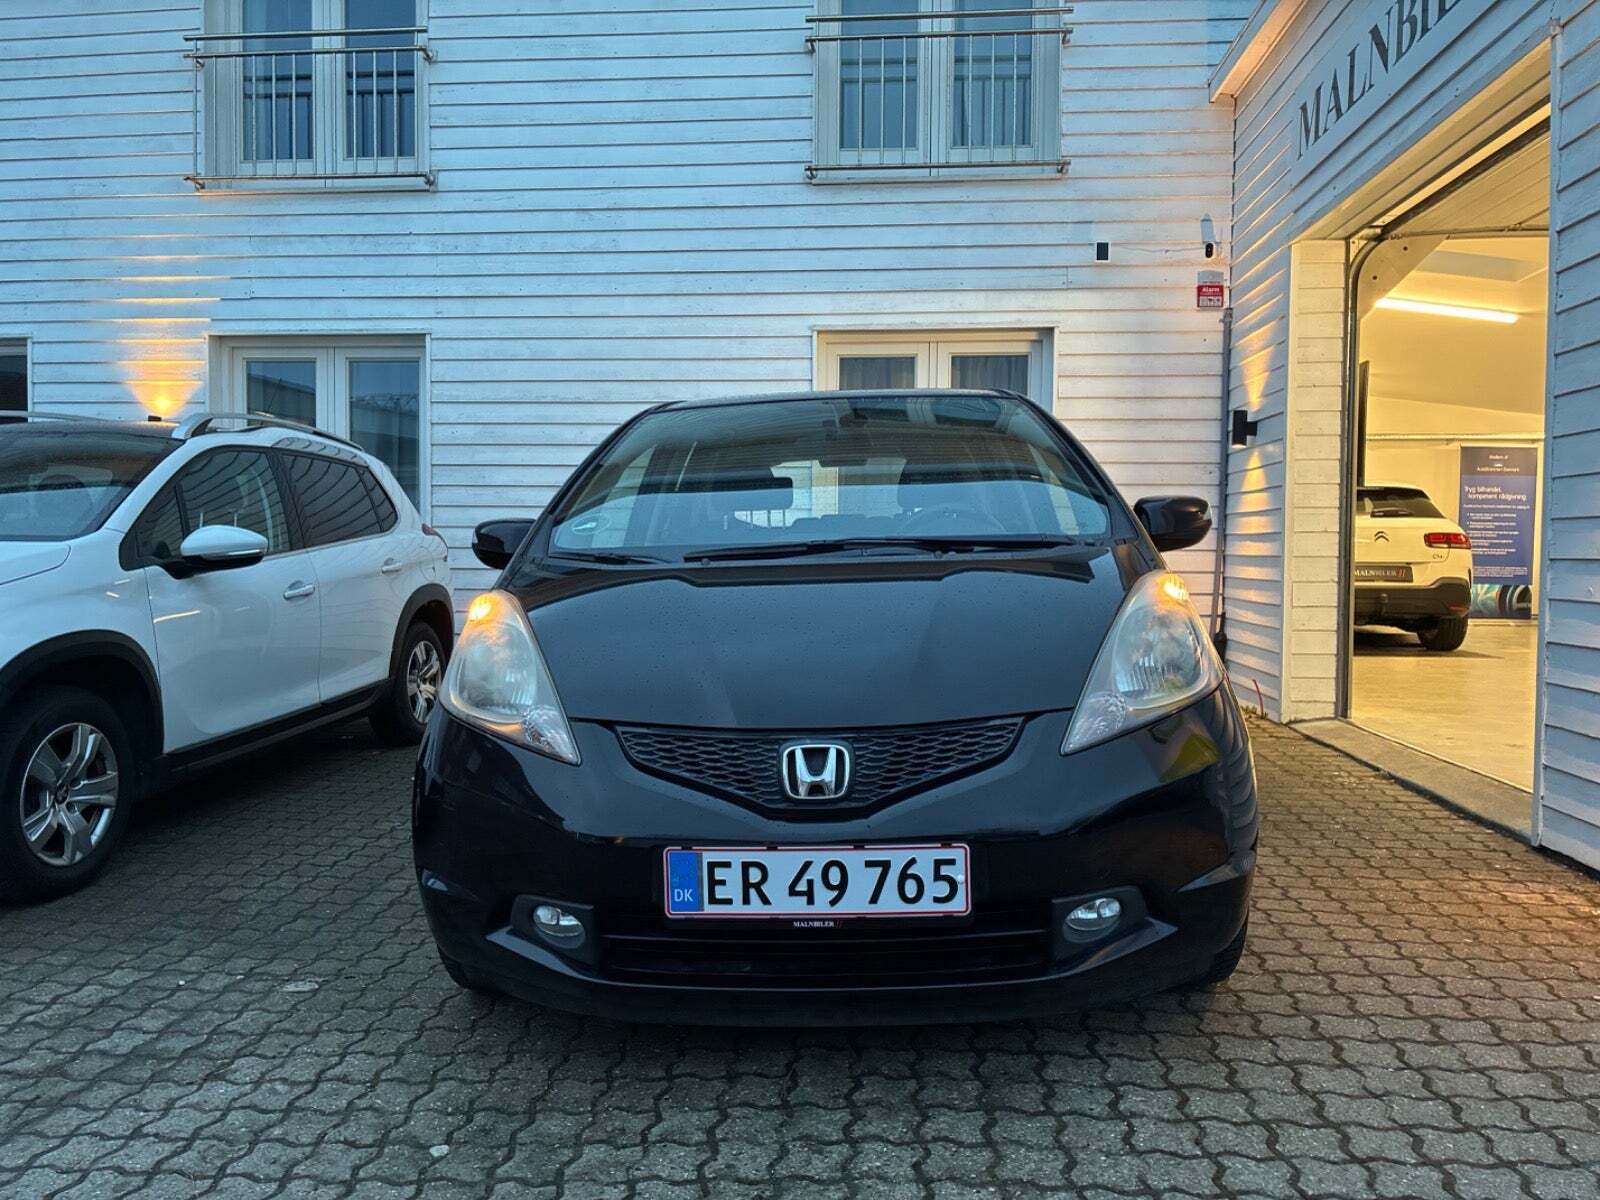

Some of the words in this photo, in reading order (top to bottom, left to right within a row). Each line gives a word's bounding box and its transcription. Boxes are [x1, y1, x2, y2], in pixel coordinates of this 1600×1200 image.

[674, 888, 694, 902] DK
[706, 860, 772, 906] ER
[788, 859, 849, 907] 49
[864, 857, 959, 905] 765
